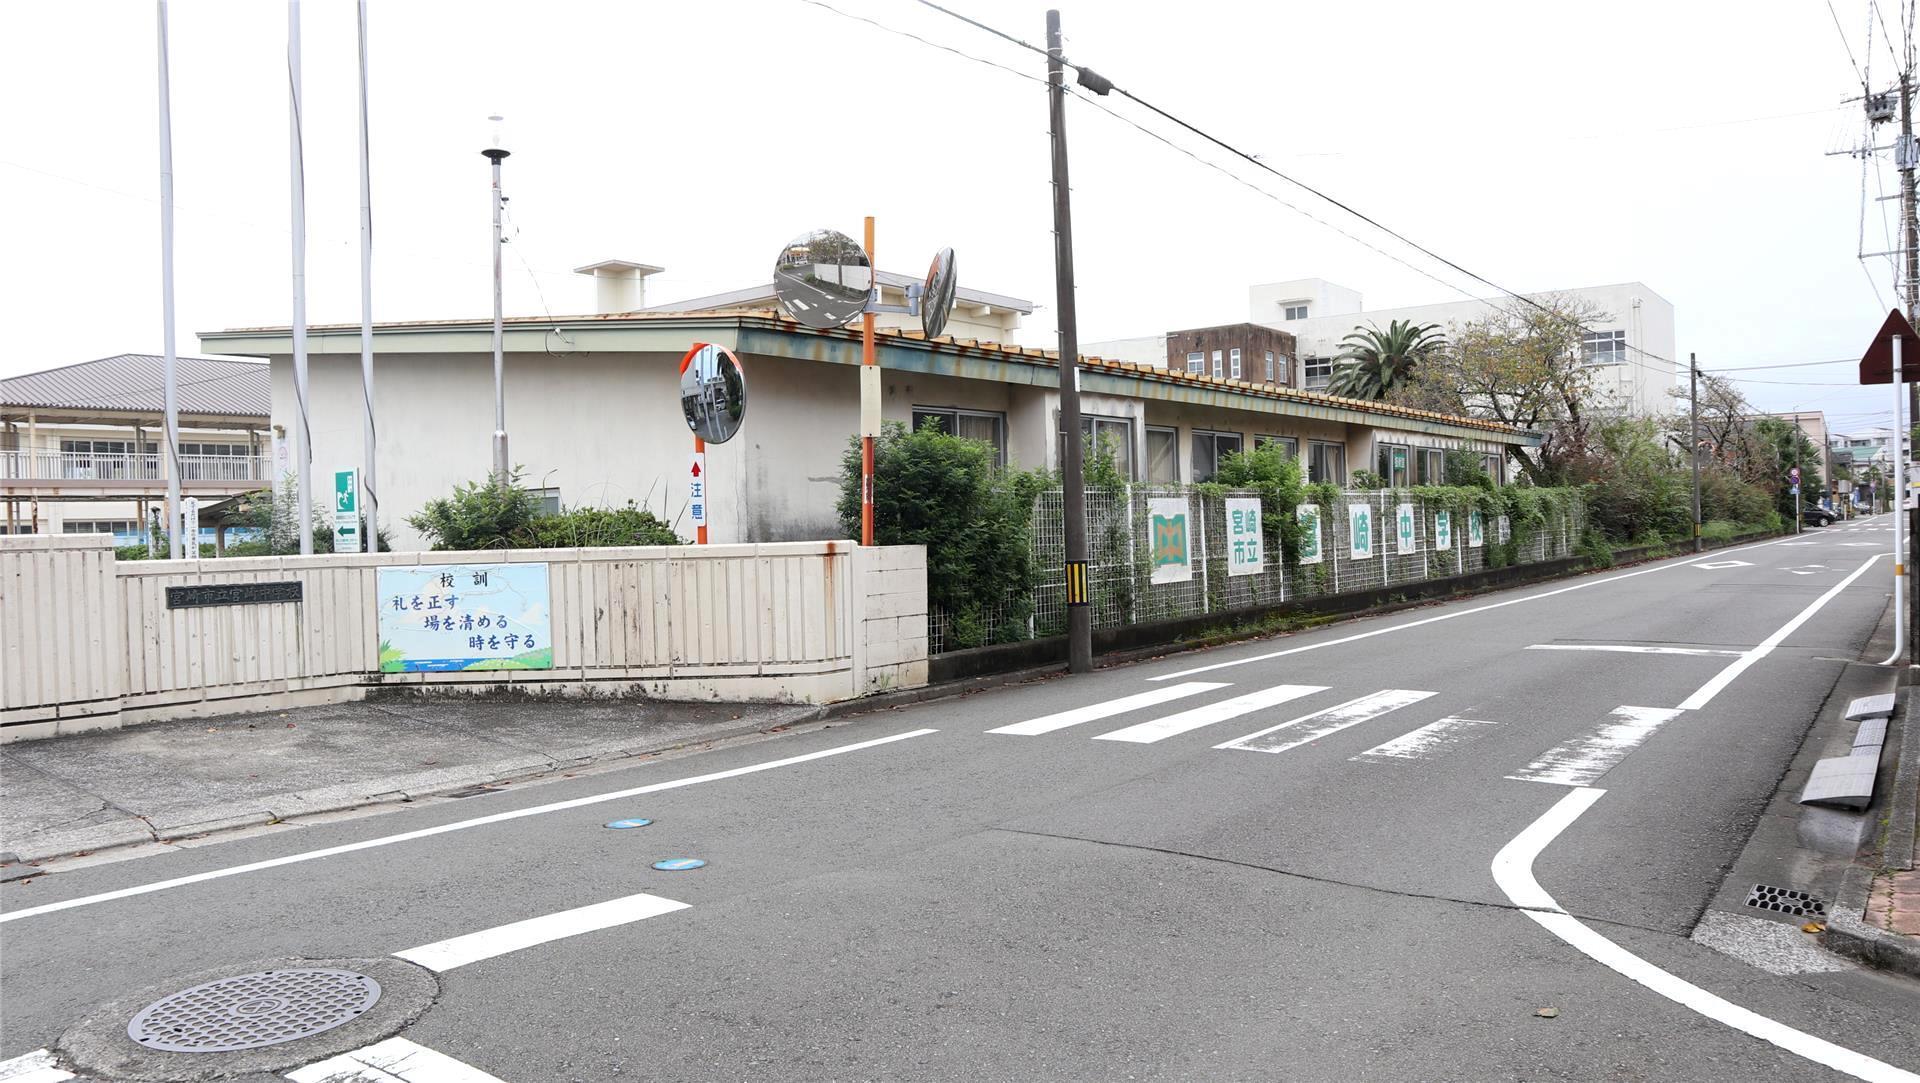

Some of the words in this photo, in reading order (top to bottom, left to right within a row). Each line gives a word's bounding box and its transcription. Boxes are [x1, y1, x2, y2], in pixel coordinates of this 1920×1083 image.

[690, 482, 703, 520] 注意
[1232, 509, 1257, 535] 宮崎
[1352, 510, 1369, 552] 崎
[1400, 509, 1412, 548] 中
[1437, 509, 1449, 546] 学
[1233, 538, 1258, 565] 市立
[170, 583, 300, 606] 宮崎市立宮崎中学校
[392, 594, 460, 611] 礼を正す
[424, 613, 508, 631] 場を清める
[468, 633, 536, 651] 時を守る
